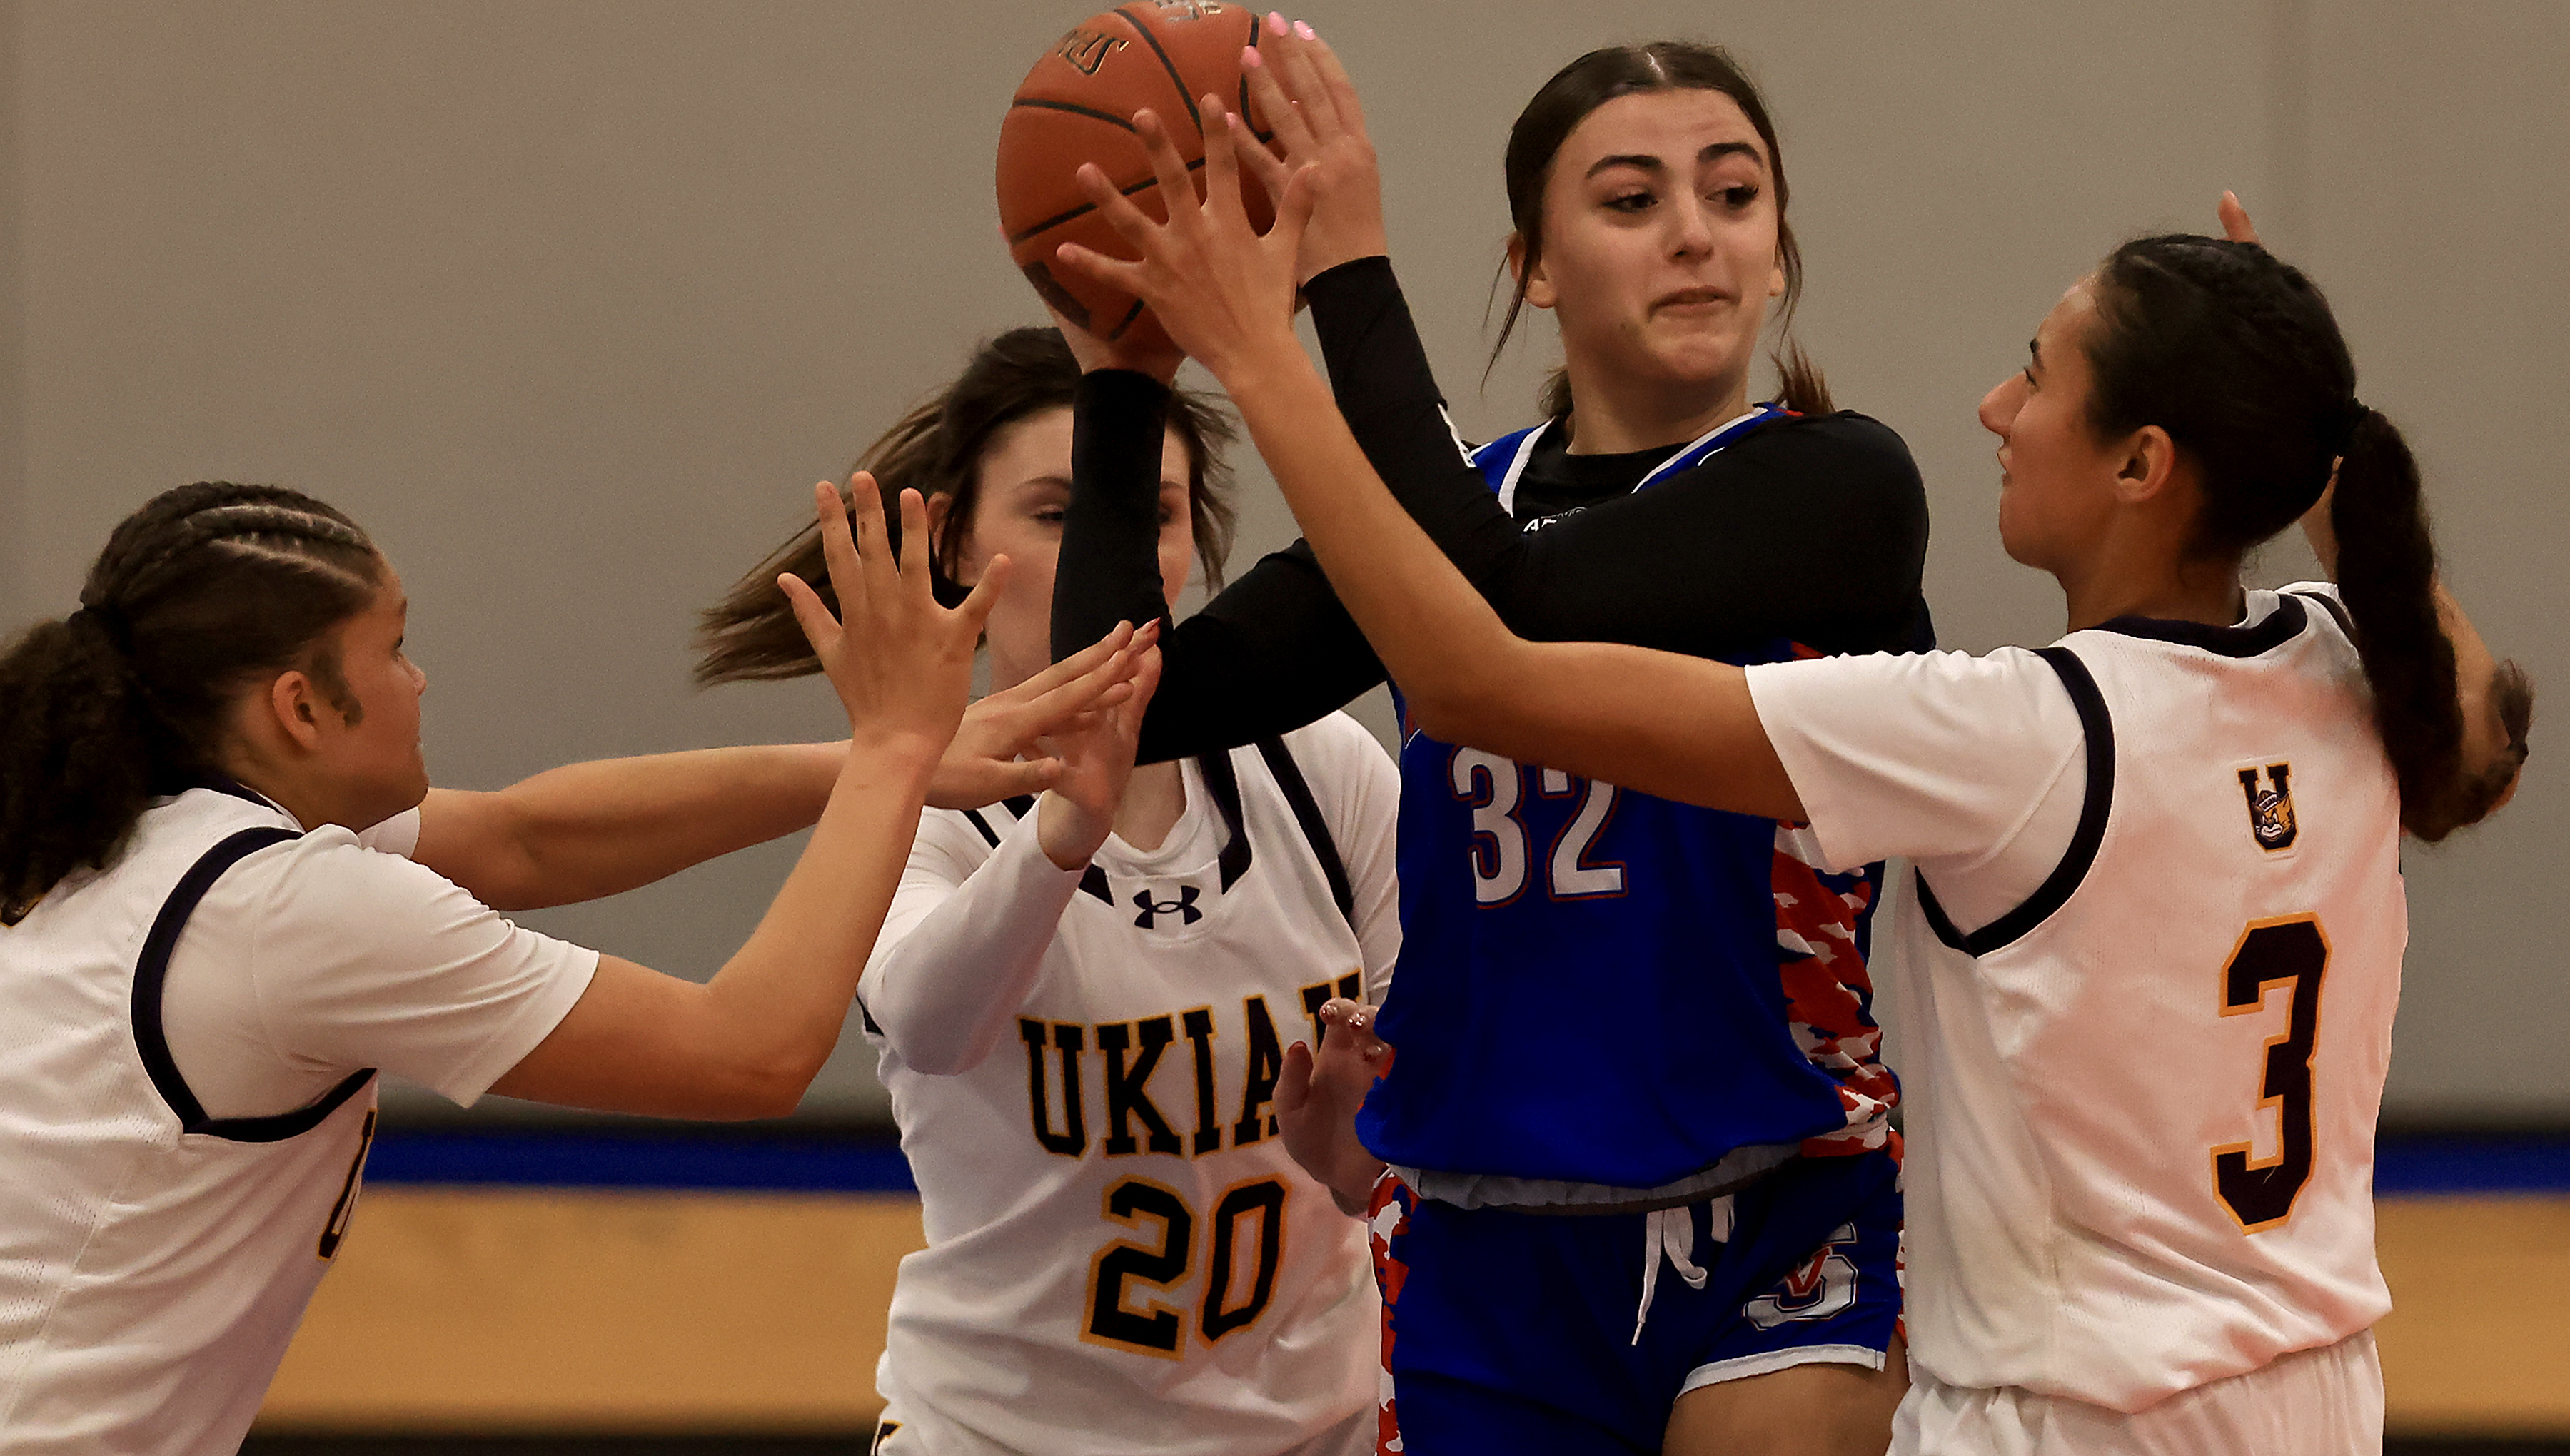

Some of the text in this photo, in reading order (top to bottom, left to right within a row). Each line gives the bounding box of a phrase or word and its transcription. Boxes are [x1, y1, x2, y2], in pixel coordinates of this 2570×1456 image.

[1447, 744, 1628, 909] 32
[2211, 911, 2332, 1235] 3
[1079, 1173, 1293, 1361] 20
